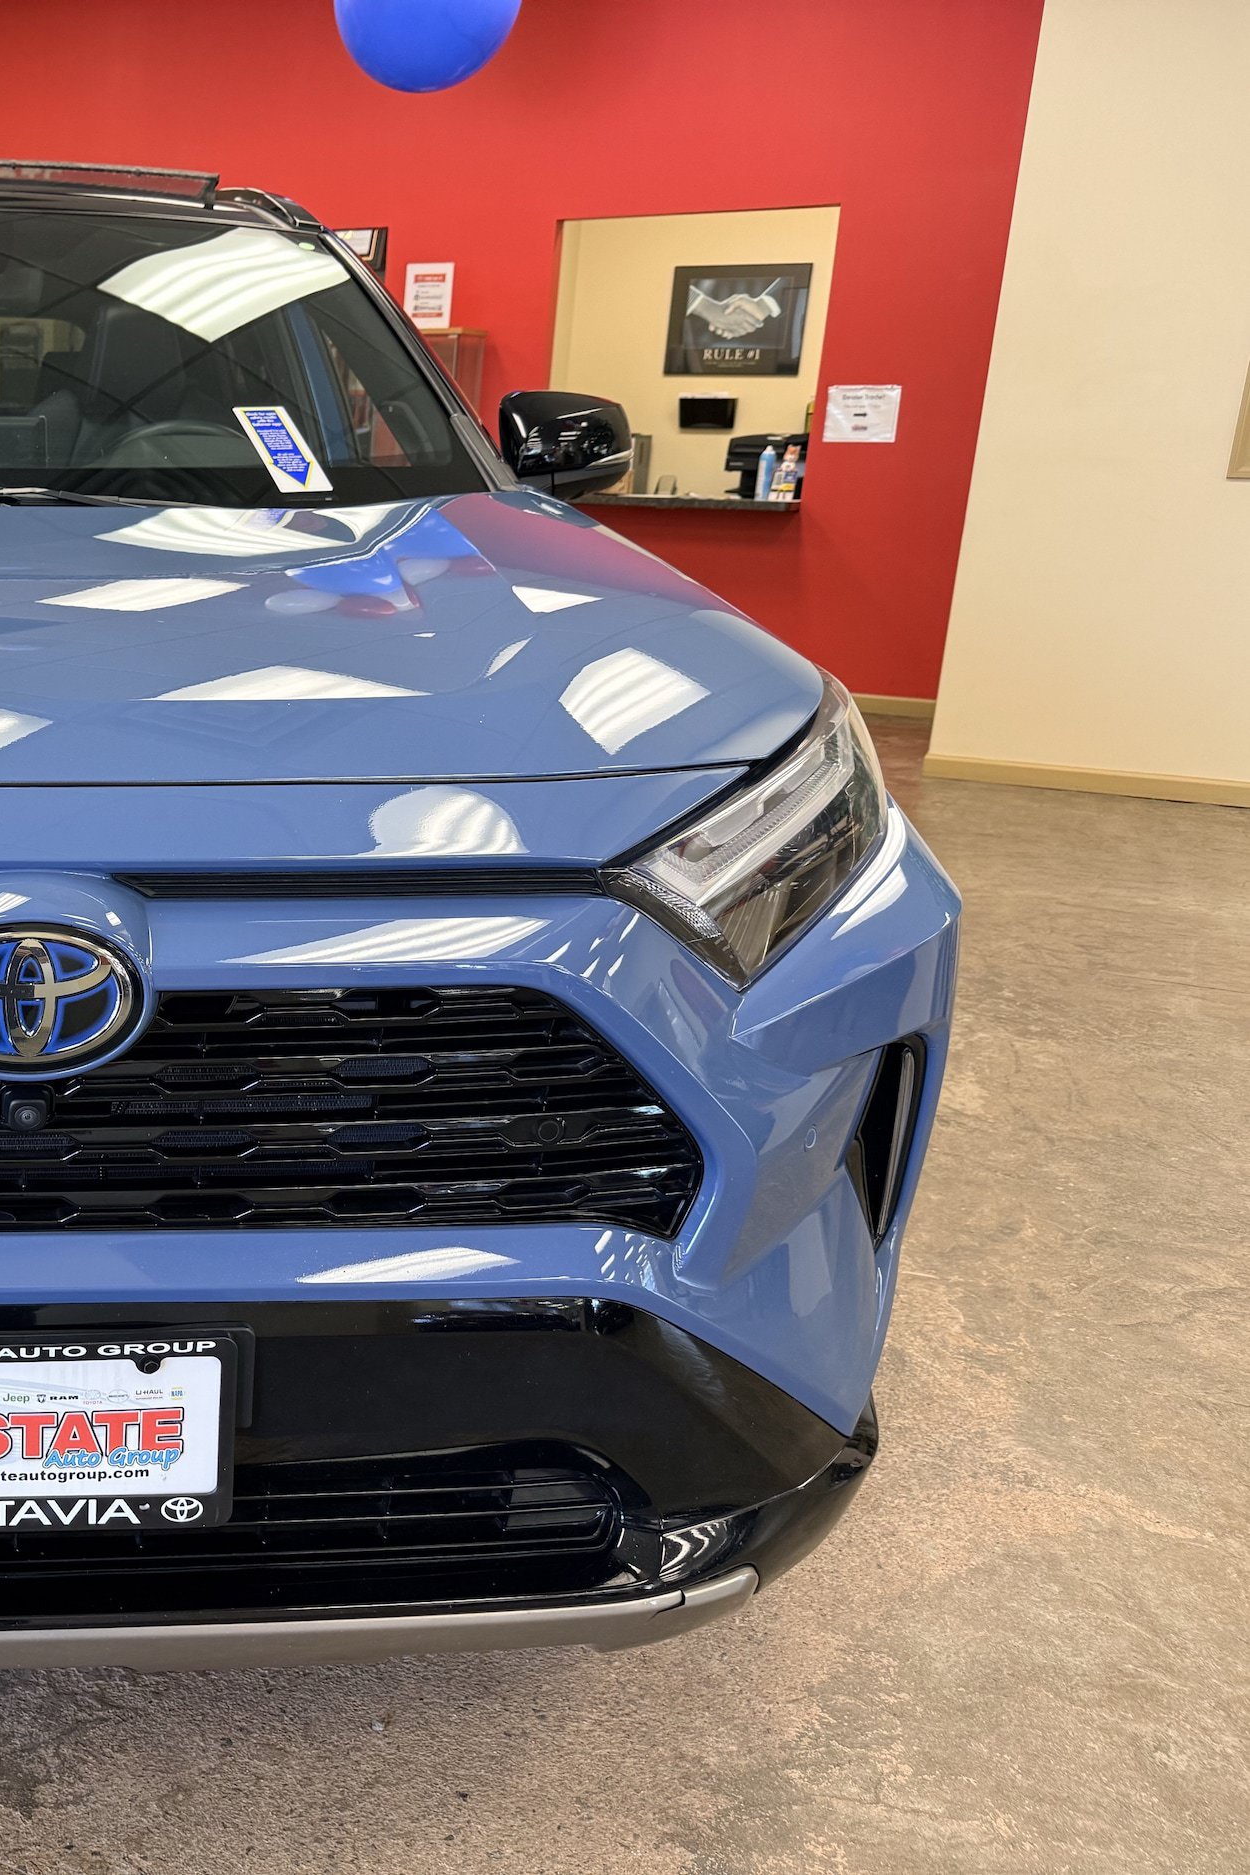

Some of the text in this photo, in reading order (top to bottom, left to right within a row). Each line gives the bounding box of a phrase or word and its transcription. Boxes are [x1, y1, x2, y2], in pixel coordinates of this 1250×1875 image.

[703, 348, 744, 360] RULE
[97, 1340, 217, 1356] GROUP
[2, 1393, 30, 1404] Jeep
[42, 1446, 182, 1471] Auto Group
